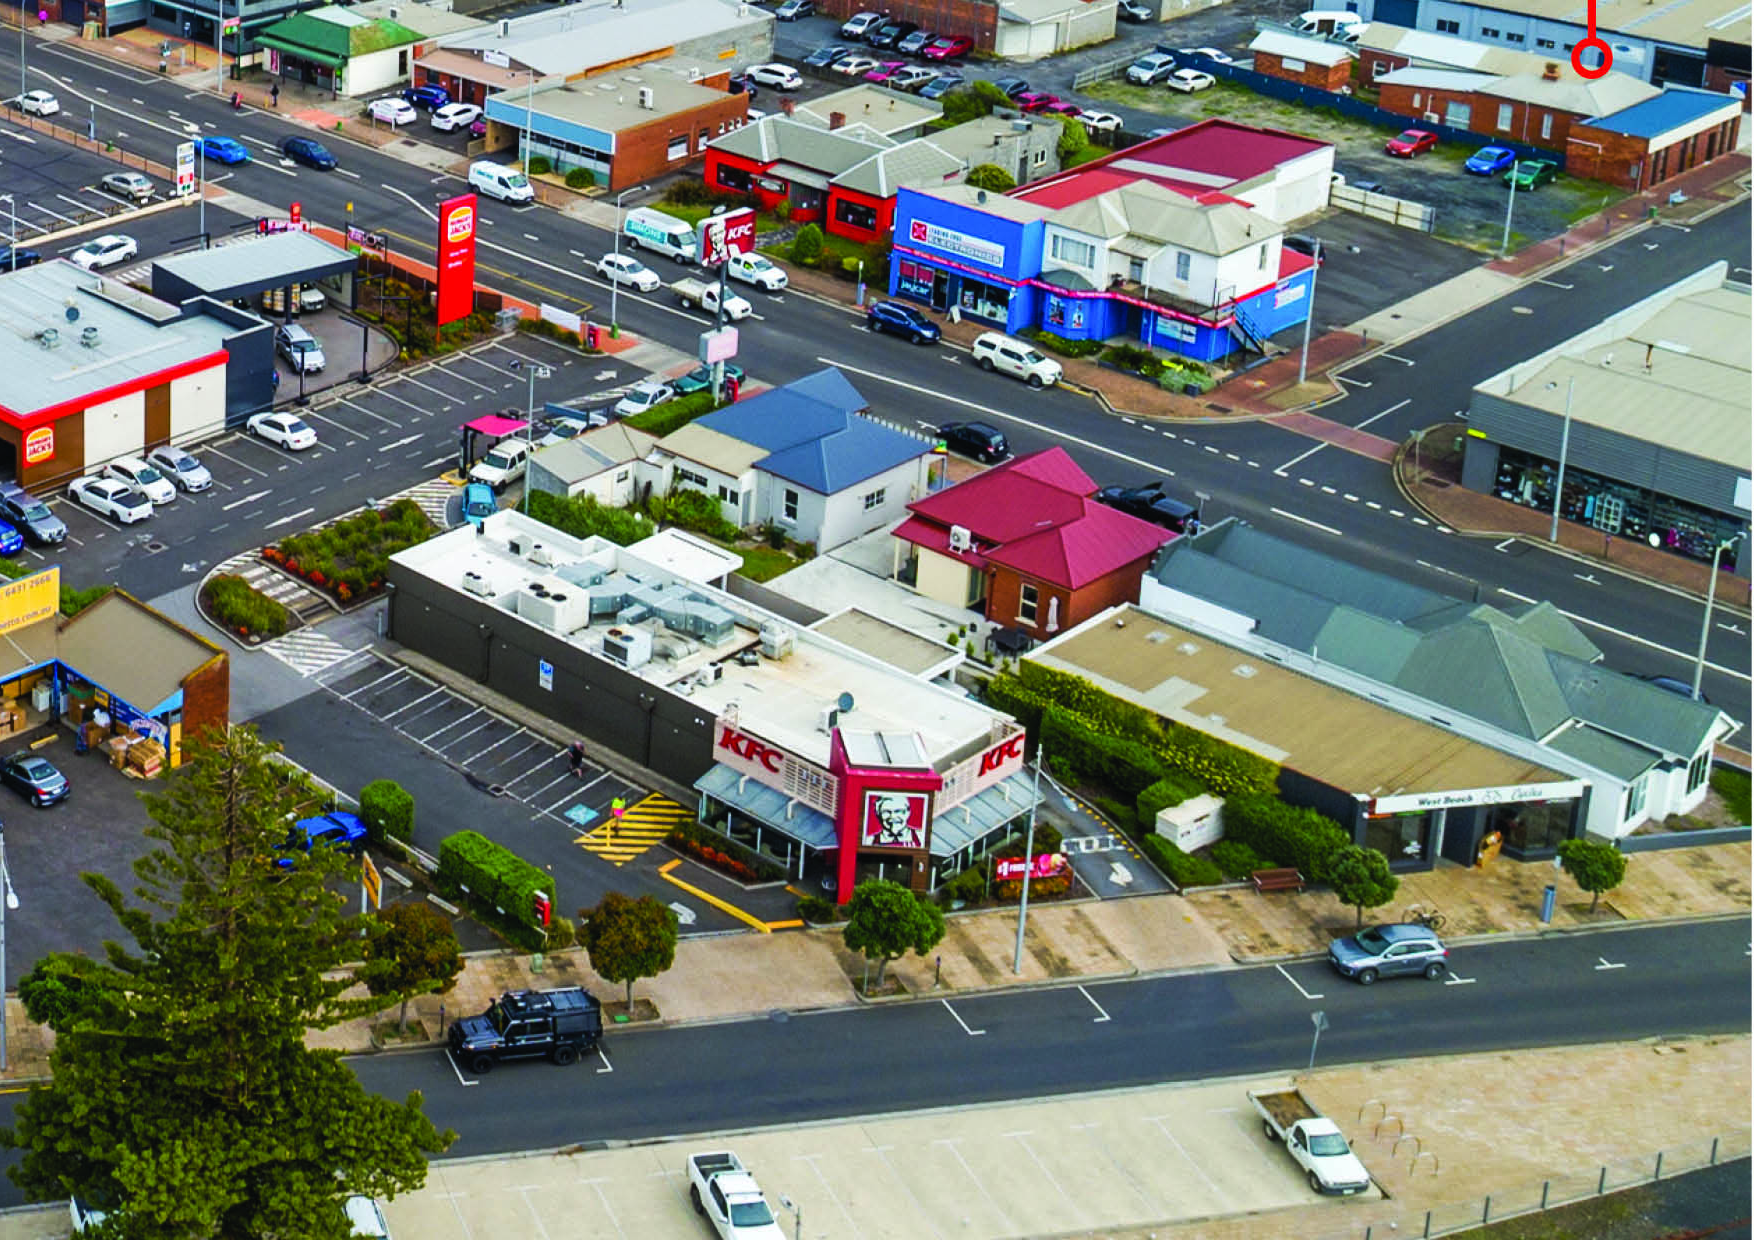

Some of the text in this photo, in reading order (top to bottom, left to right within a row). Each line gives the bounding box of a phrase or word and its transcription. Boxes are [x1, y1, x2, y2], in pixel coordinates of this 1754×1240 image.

[727, 223, 753, 240] KFC
[900, 279, 930, 296] jaycar
[719, 727, 784, 773] KFC
[978, 734, 1025, 777] KFC
[1418, 797, 1441, 807] West
[1444, 794, 1473, 805] Beach
